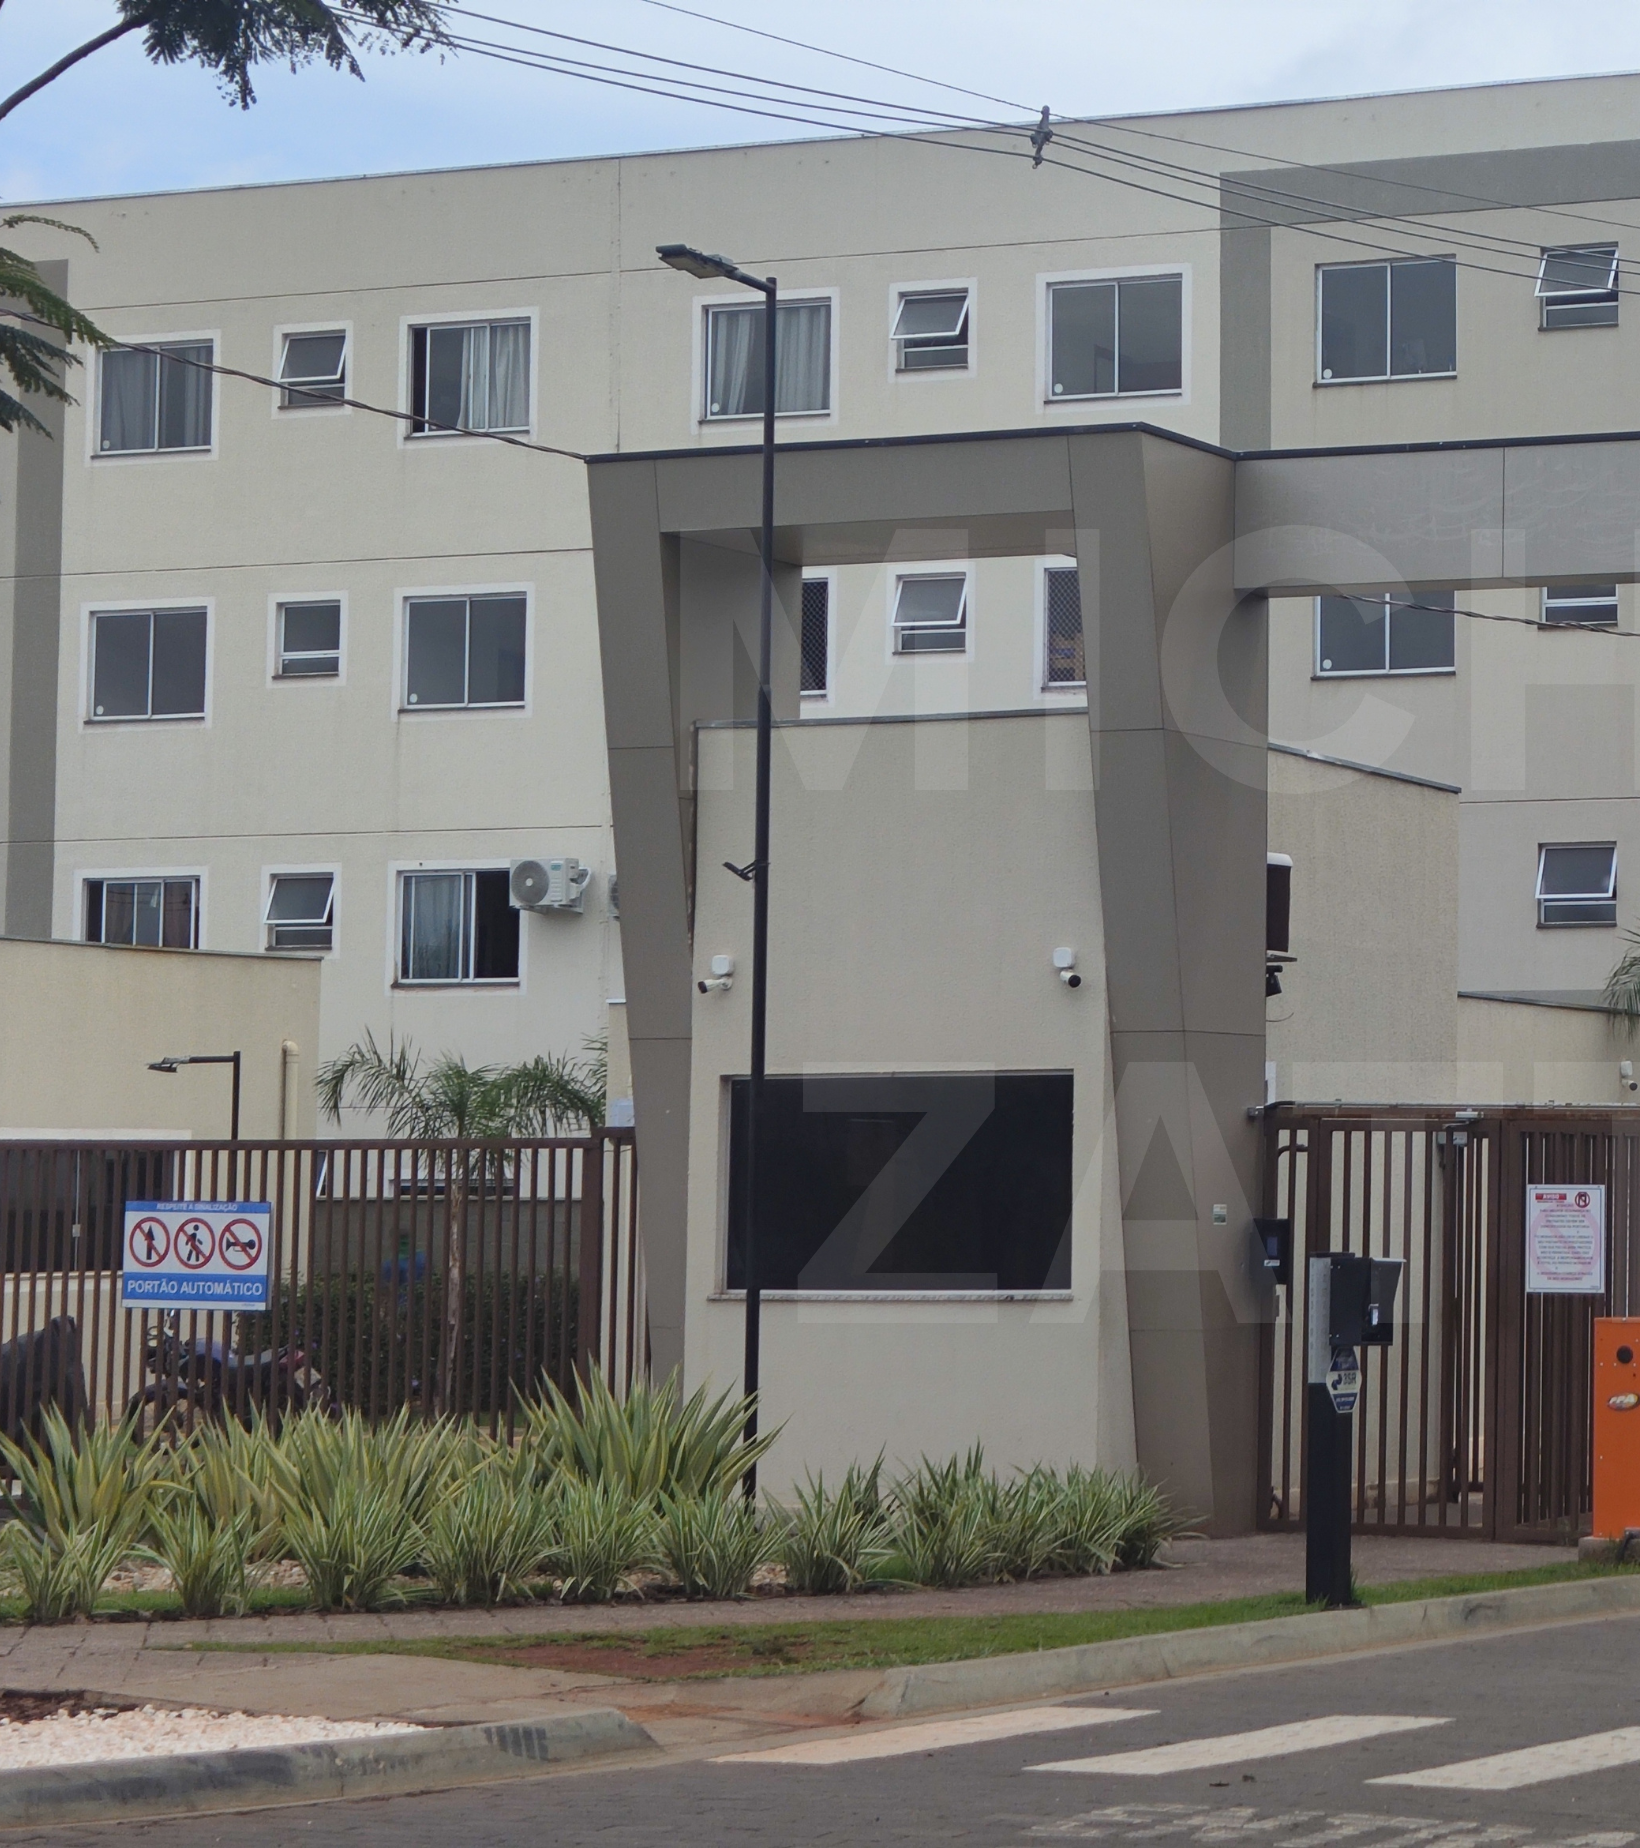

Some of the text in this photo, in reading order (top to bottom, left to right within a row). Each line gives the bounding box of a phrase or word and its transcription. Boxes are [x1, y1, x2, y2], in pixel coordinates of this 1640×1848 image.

[156, 1203, 187, 1211] RESPEITE
[195, 1203, 238, 1212] SINALIZAÇÃO
[127, 1278, 263, 1296] PORTÃO AUTOMÁTICO
